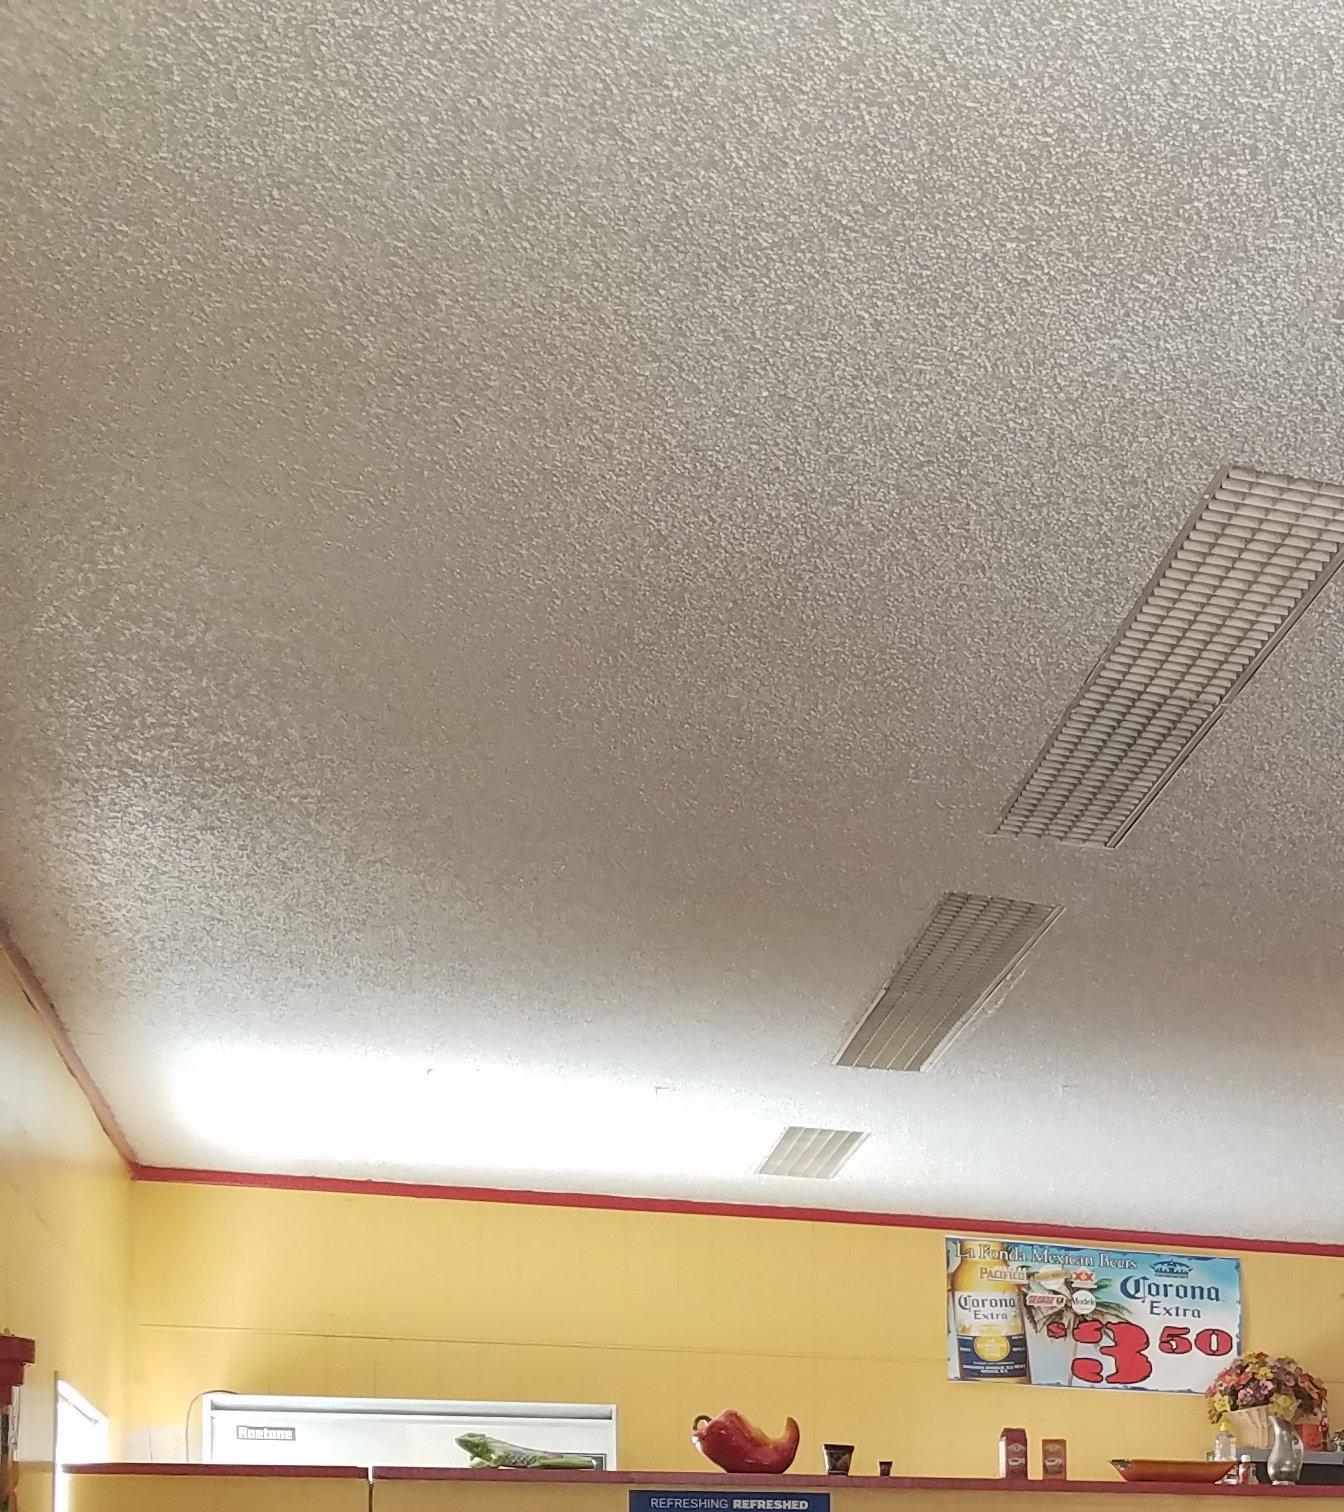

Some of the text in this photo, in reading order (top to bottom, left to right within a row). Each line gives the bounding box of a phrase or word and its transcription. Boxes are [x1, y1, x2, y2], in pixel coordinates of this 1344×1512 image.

[955, 1243, 1138, 1270] La Fonda Mexican Beers
[1120, 1275, 1221, 1302] Corona
[958, 1294, 1017, 1310] Corona
[974, 1310, 1008, 1321] Extra
[1151, 1303, 1202, 1319] Extra
[650, 1497, 809, 1511] REFRESHING REFRESHED
